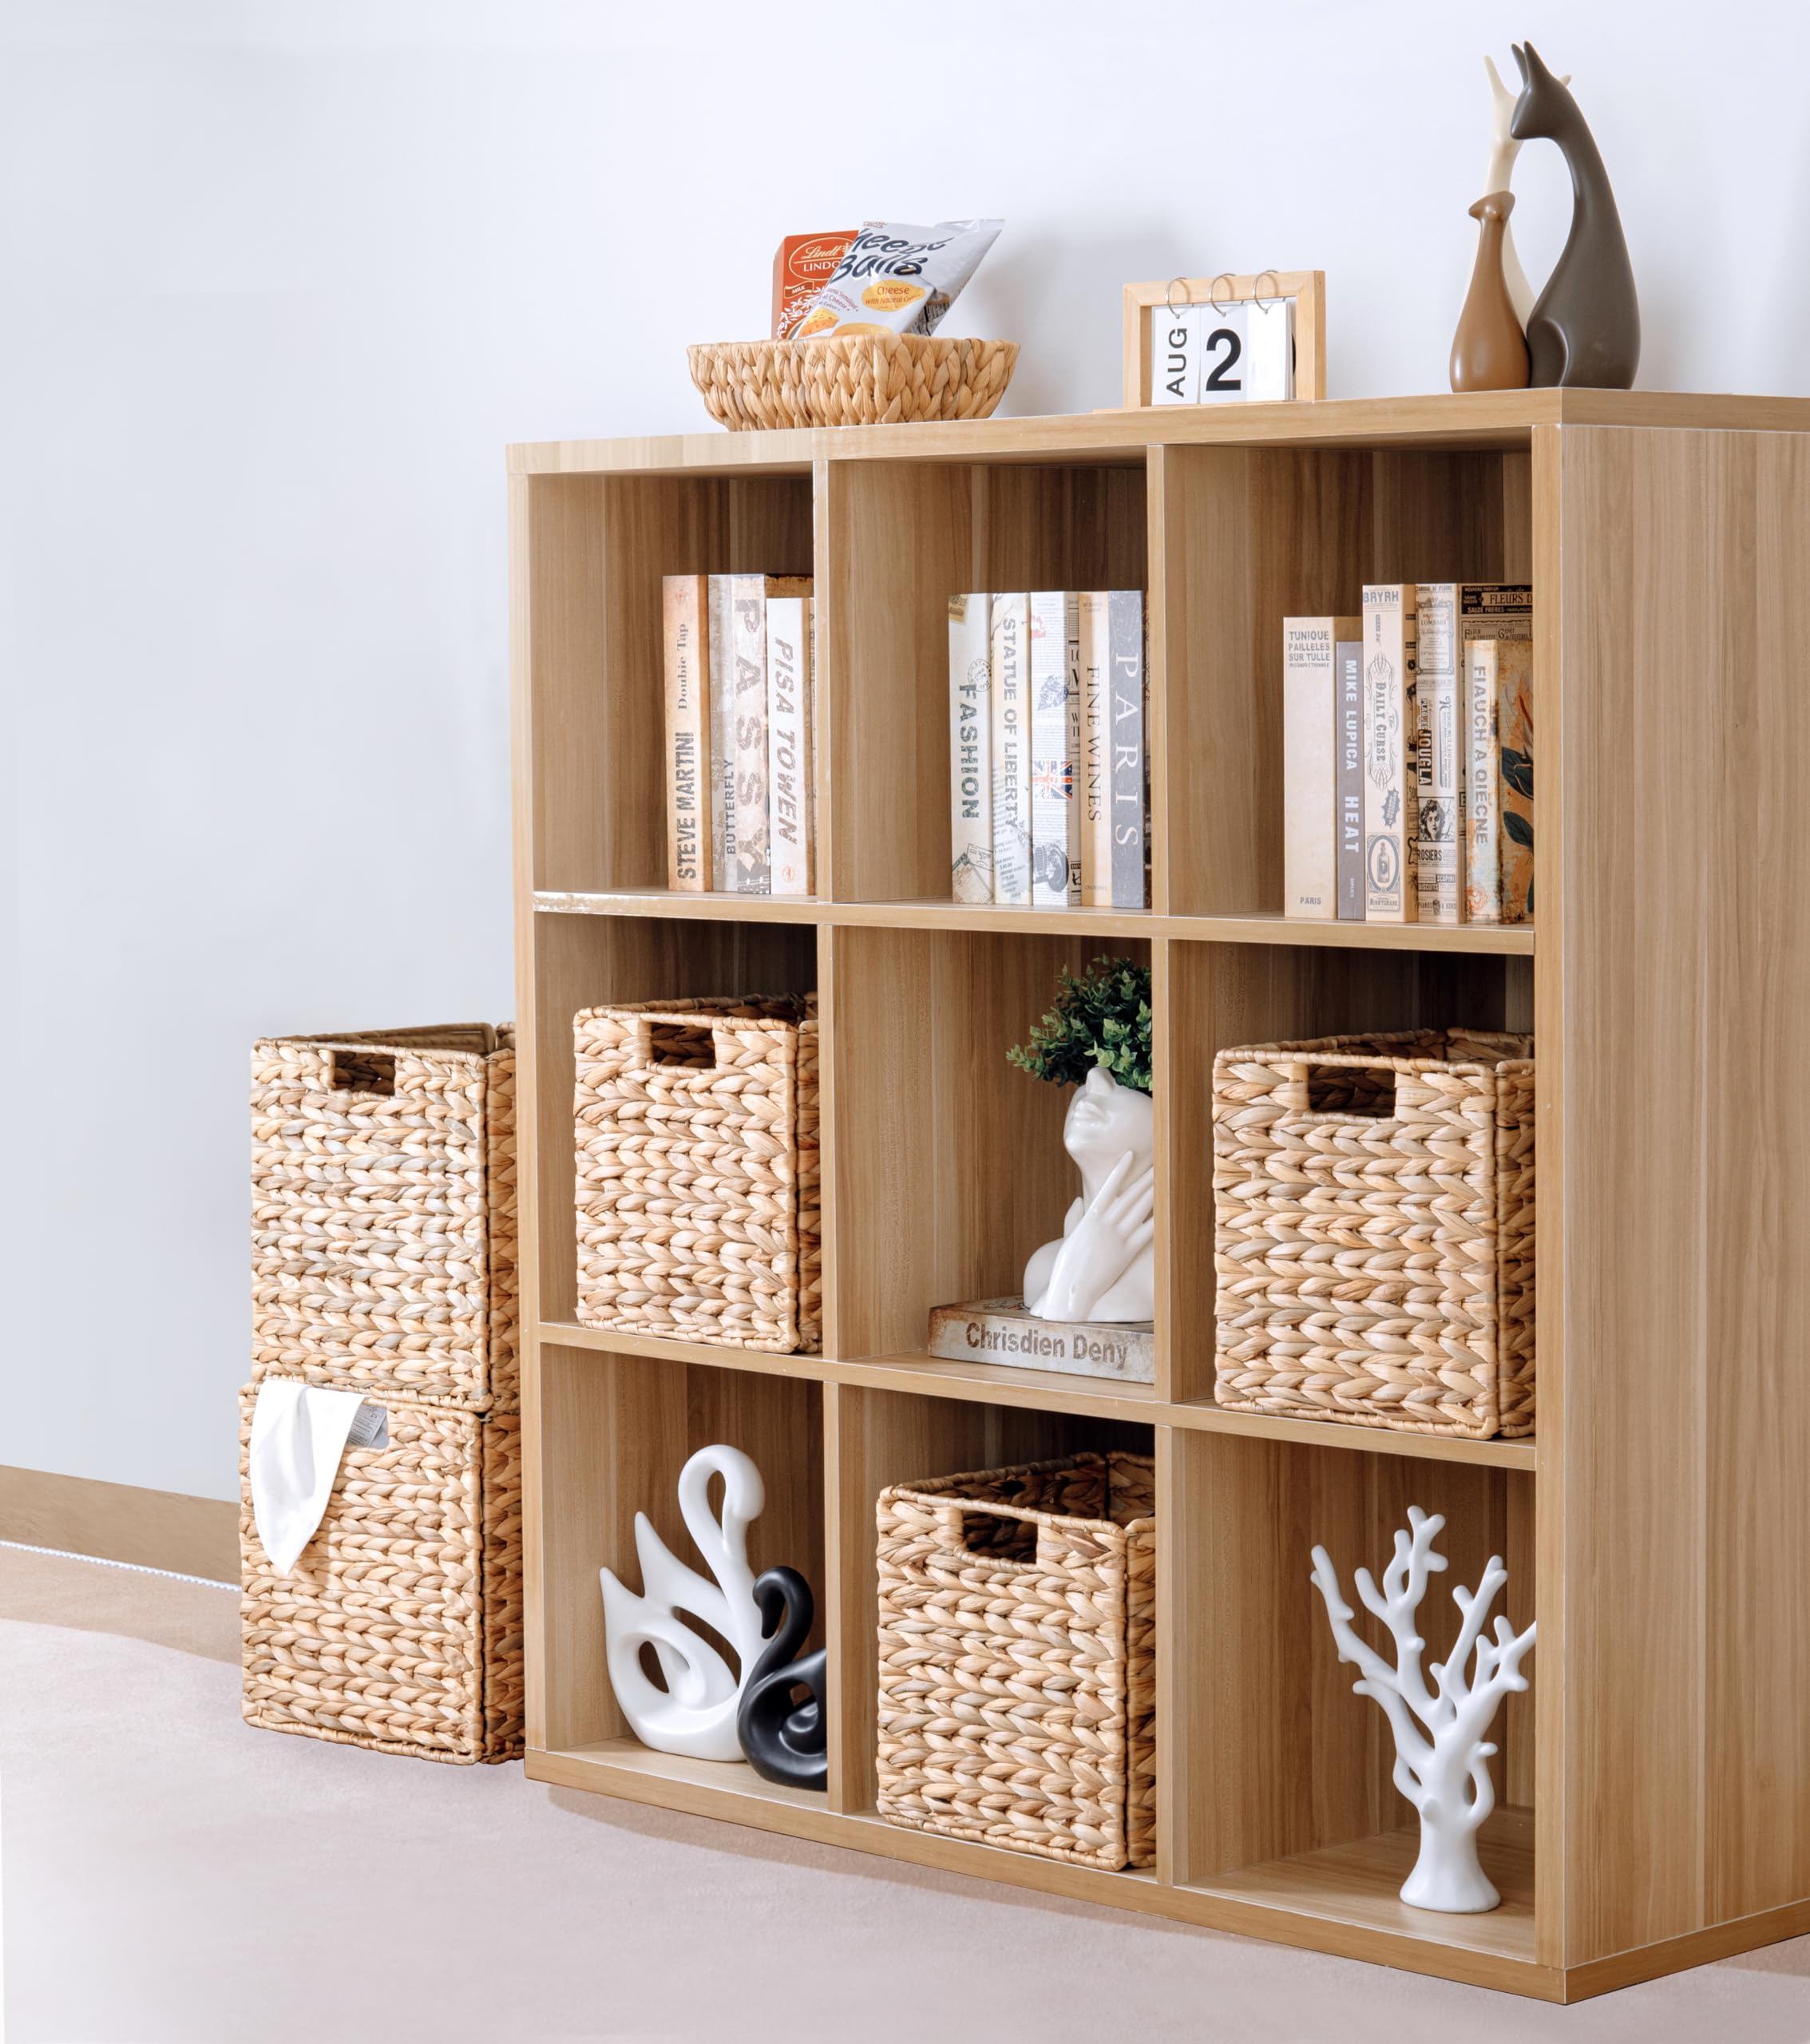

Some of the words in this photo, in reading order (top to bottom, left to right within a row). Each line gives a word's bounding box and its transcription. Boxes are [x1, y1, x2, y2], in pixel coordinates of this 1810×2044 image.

[801, 245, 840, 259] Lindt
[803, 260, 841, 272] LINDO
[791, 284, 806, 295] MILK
[877, 286, 910, 295] Cheese
[1166, 327, 1188, 398] AUG
[1206, 328, 1242, 391] 2
[1490, 593, 1523, 604] FLEURS
[676, 623, 690, 651] Tap
[1003, 618, 1017, 701] STATUE
[1289, 630, 1329, 640] TUNIQUE
[1289, 642, 1330, 652] PAILLELES
[1289, 652, 1305, 662] SUR
[1306, 652, 1331, 662] TULLE
[774, 637, 795, 715] PISA
[1087, 667, 1100, 727] FINE
[1345, 660, 1357, 702] MIKE
[1375, 682, 1387, 720] DAILY
[1004, 709, 1017, 734] OF
[1345, 711, 1358, 770] LUPICA
[1375, 724, 1387, 762] CURSE
[675, 731, 695, 811] MARTINI
[959, 683, 980, 819] FASHION
[1115, 652, 1139, 846] PARIS
[1418, 730, 1432, 785] JOUGLA
[1475, 748, 1487, 763] A
[1004, 743, 1019, 829] LIBERTY
[1087, 737, 1101, 822] WINES
[724, 759, 736, 855] BUTTERFLY
[1345, 796, 1360, 854] HEAT
[676, 818, 696, 880] STEVE
[965, 1322, 1065, 1357] Chrisdien
[1073, 1334, 1129, 1371] Deny
